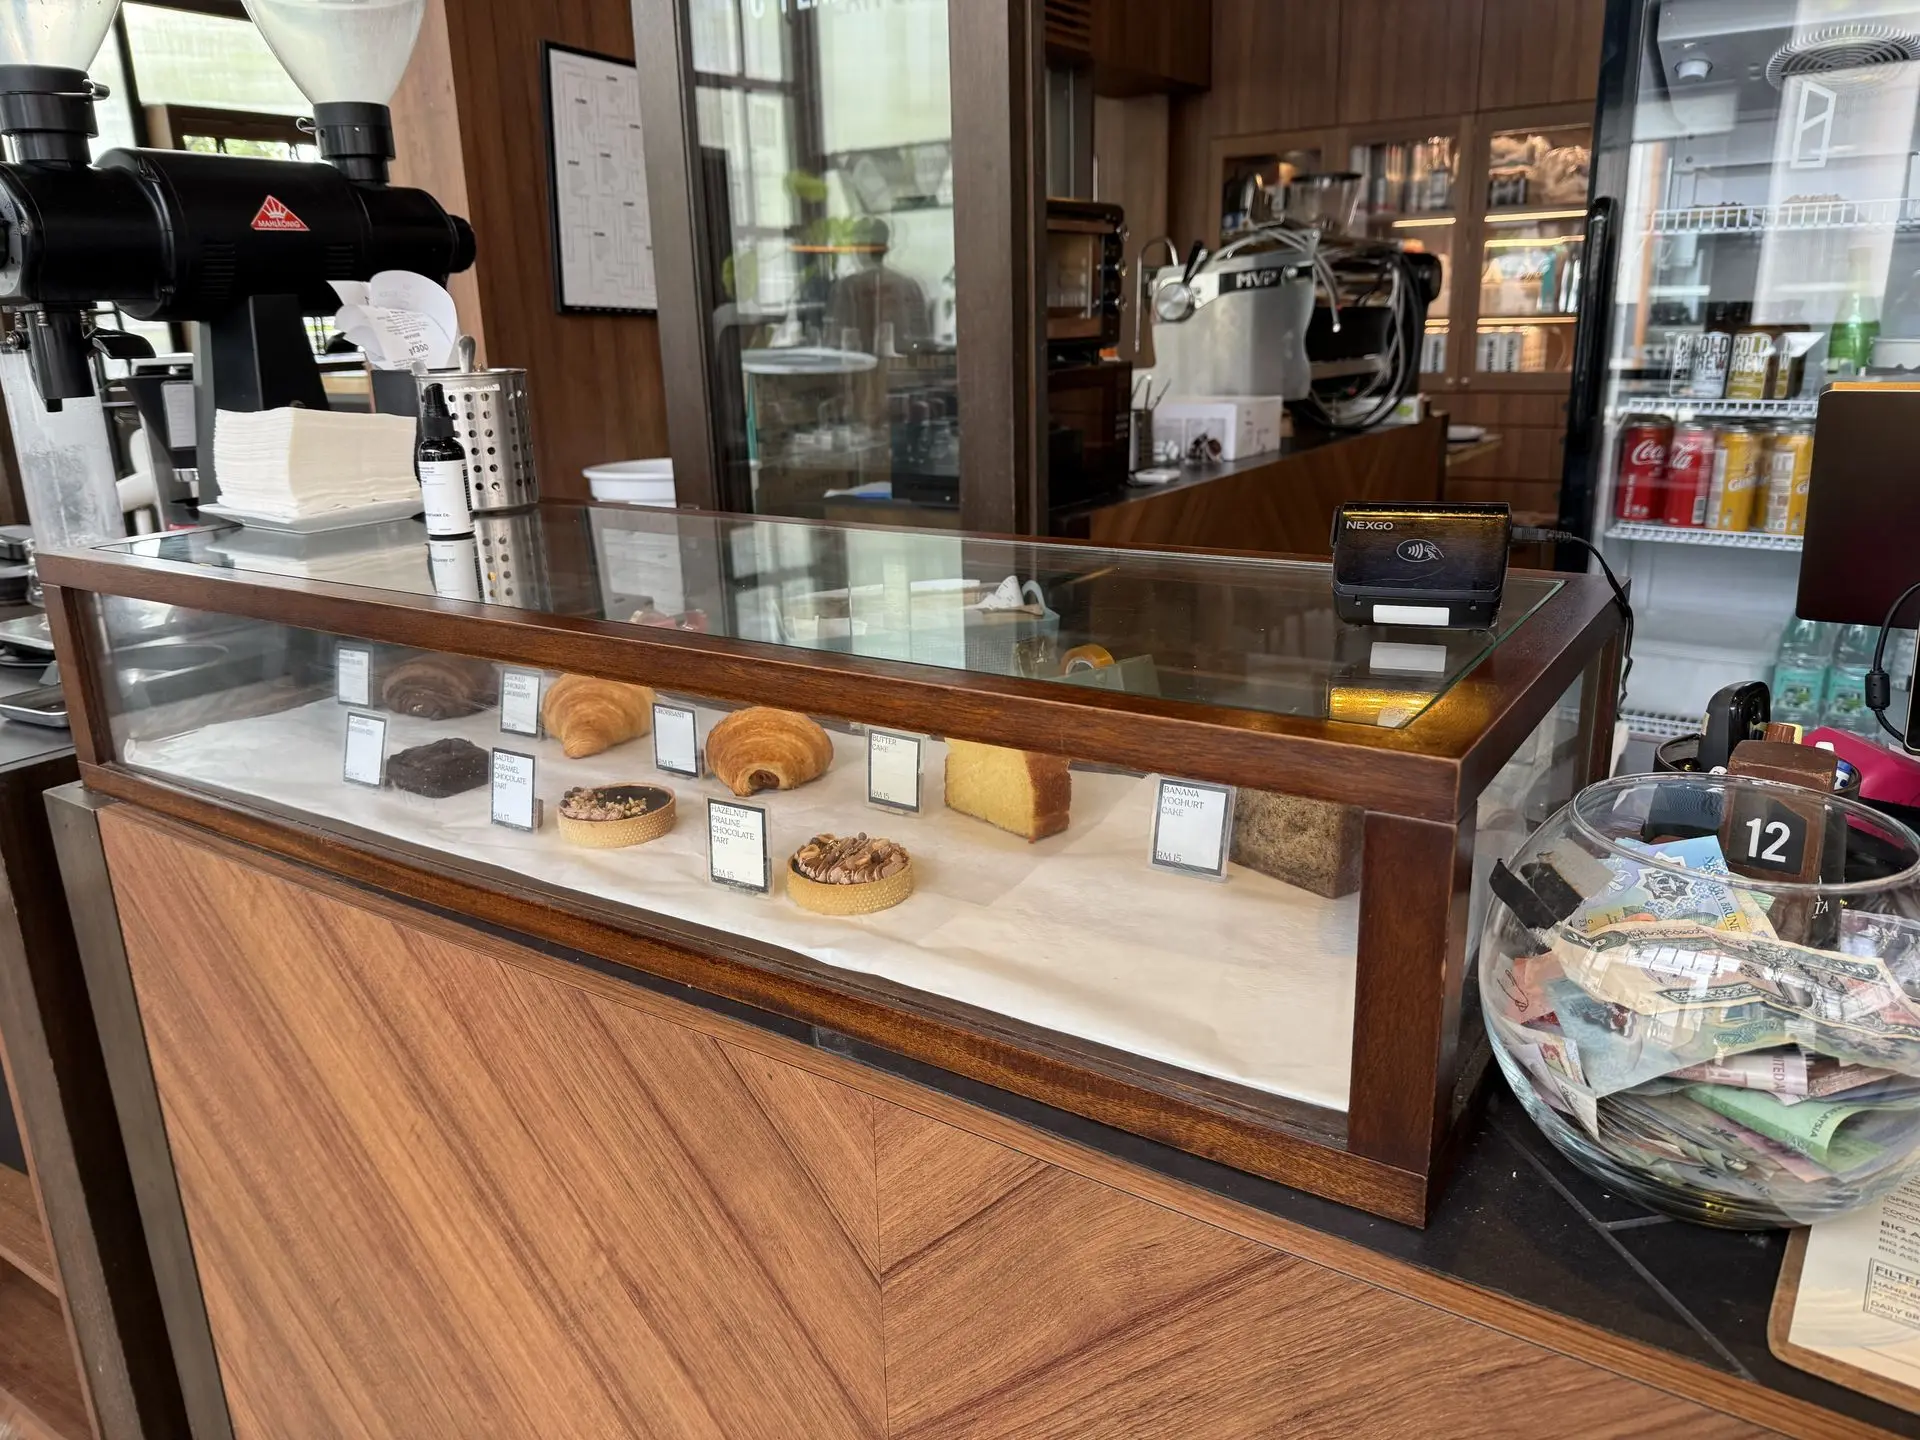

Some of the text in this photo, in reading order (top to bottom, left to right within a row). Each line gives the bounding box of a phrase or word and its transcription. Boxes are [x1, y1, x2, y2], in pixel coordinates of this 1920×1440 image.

[1346, 520, 1394, 530] NEXGO
[655, 707, 685, 719] CROISSANT
[872, 735, 897, 746] BUTTER
[872, 744, 888, 753] CAKE
[495, 753, 515, 764] SALTED
[494, 763, 519, 774] CARAMEL
[494, 772, 527, 785] CHOCOLATE
[1163, 785, 1200, 798] BANANA
[1162, 796, 1205, 809] YOGHURT
[711, 804, 748, 819] HAZELNUT
[1161, 806, 1184, 817] CAKE
[711, 815, 741, 828] PRALINE
[712, 825, 755, 841] CHOCOLATE
[713, 835, 729, 845] TART
[1746, 817, 1791, 863] 12
[1156, 850, 1182, 862] RM 15
[1881, 1220, 1906, 1234] BIG
[1880, 1229, 1898, 1239] BIG
[1879, 1237, 1897, 1247] BIG
[1878, 1245, 1896, 1254] BIG
[1873, 1280, 1907, 1294] HAND
[1870, 1299, 1903, 1314] DAILY
